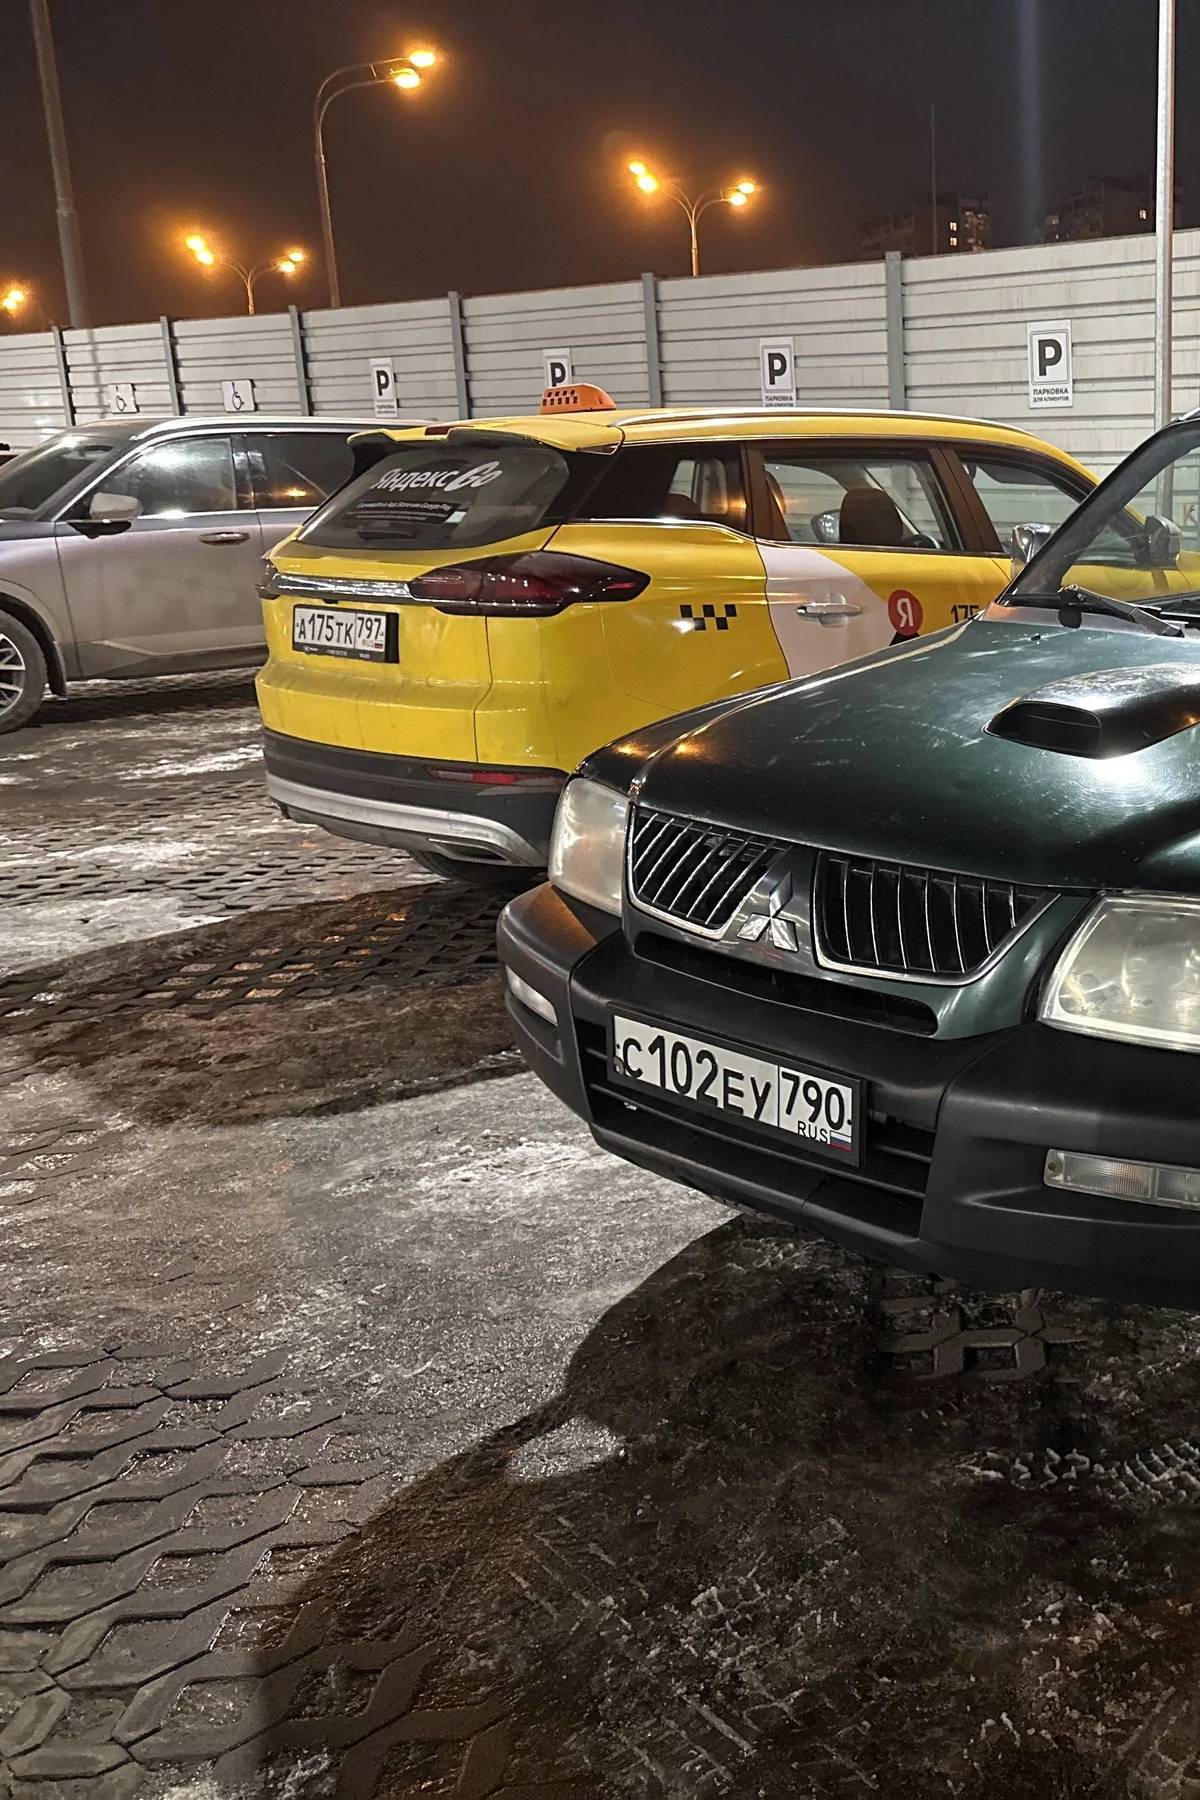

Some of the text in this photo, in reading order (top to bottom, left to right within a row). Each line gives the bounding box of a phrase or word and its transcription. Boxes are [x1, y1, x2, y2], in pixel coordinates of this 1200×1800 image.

[767, 352, 788, 386] P
[1038, 338, 1063, 377] P
[375, 369, 390, 397] P
[549, 361, 567, 388] P
[1033, 387, 1069, 395] ПАРКОВКА
[370, 460, 503, 492] Яндекс Go
[896, 597, 914, 628] Я
[797, 1120, 829, 1144] RUS
